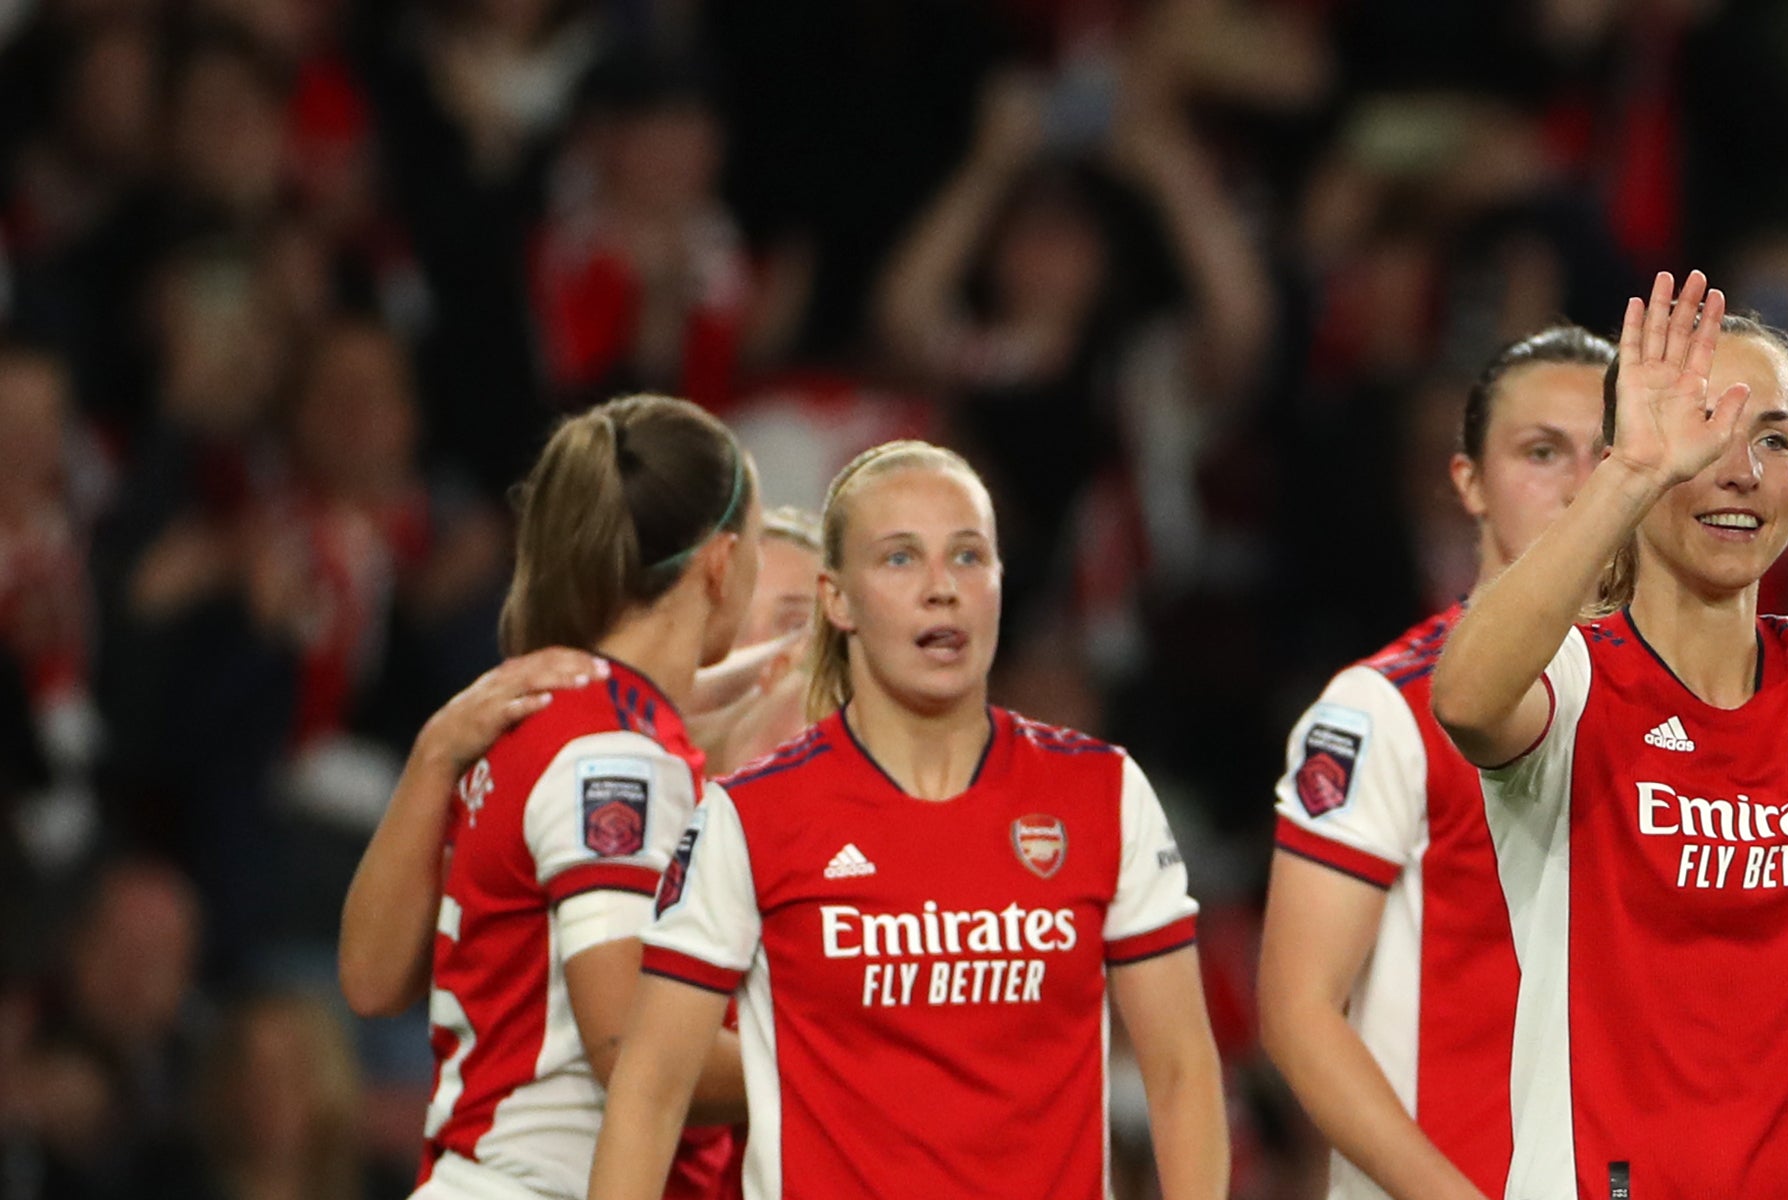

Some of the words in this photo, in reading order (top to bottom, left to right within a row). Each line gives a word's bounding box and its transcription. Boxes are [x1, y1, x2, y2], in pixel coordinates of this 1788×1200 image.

[1644, 732, 1695, 752] adidas
[1676, 843, 1736, 889] FLY
[819, 900, 1078, 959] Emirates
[862, 962, 919, 1008] FLY
[927, 959, 1046, 1005] BETTER
